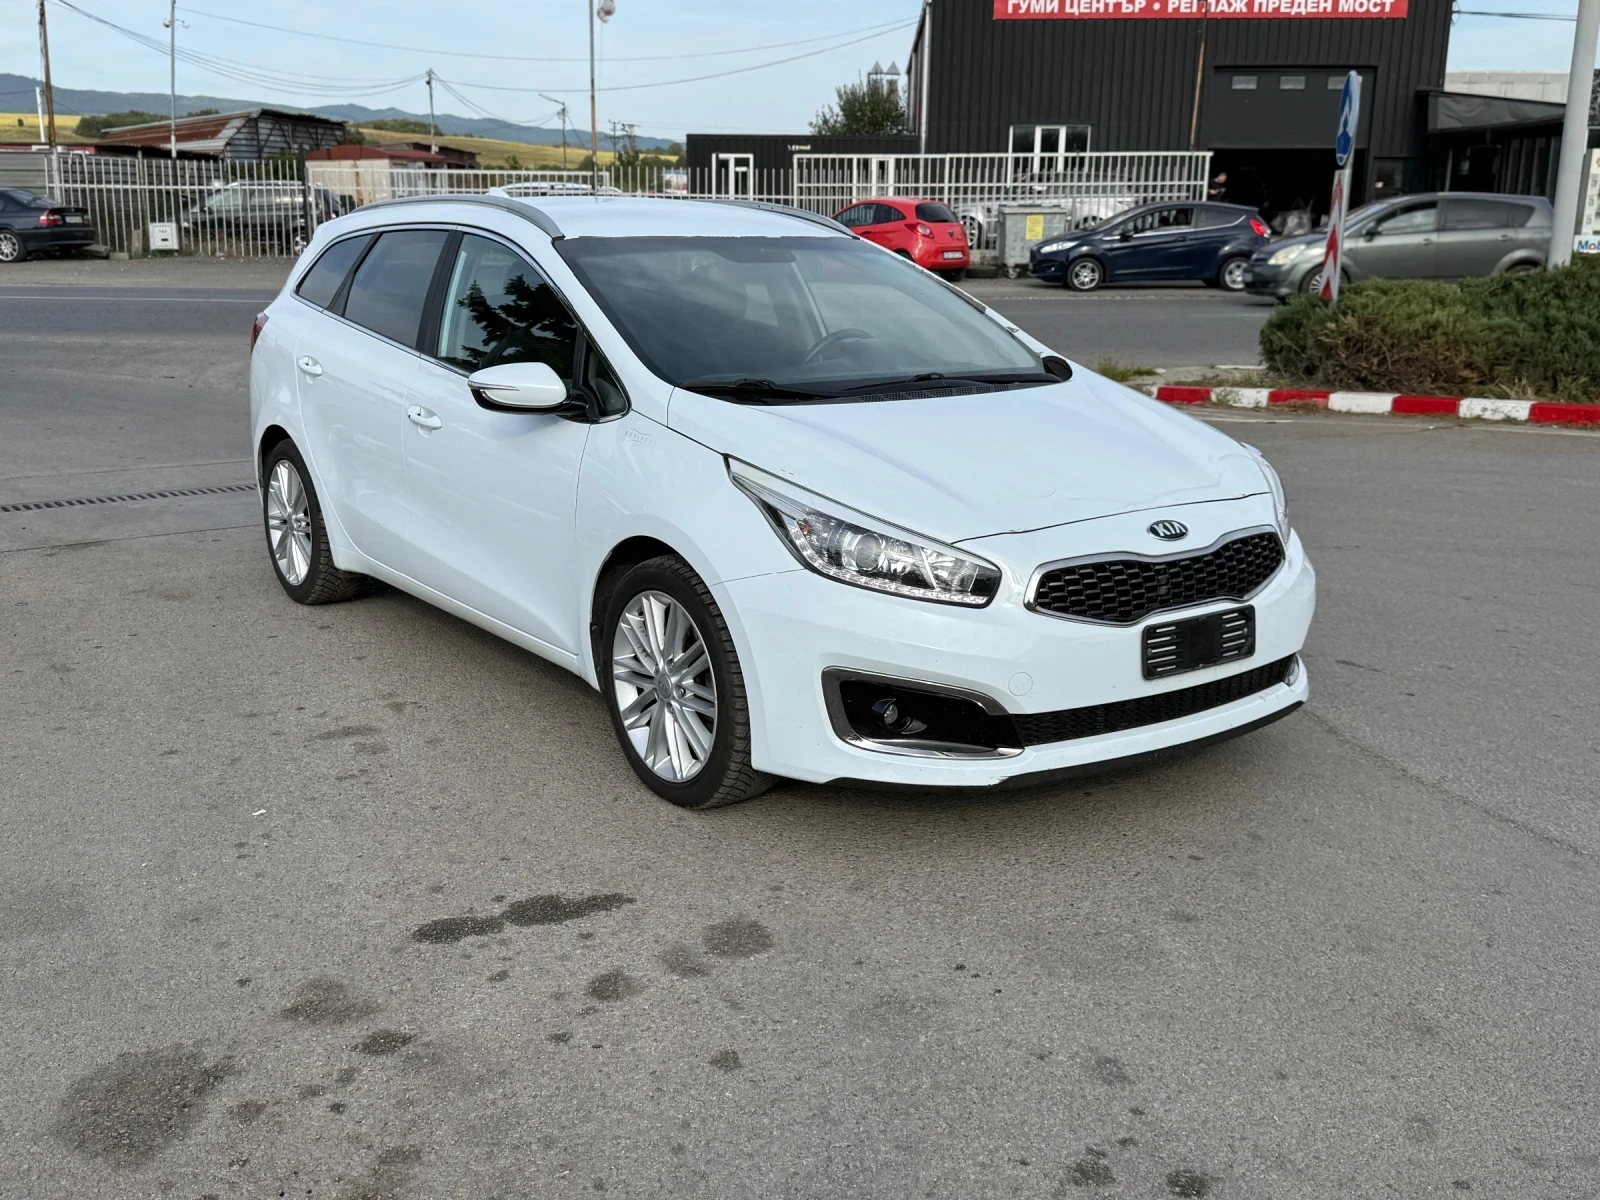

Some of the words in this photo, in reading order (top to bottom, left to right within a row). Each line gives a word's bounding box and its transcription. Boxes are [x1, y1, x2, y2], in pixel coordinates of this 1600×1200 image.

[1007, 0, 1059, 13] ГУМИ
[1064, 0, 1147, 15] ЦЕНТЪР
[1253, 0, 1333, 15] ПРЕДЕН
[1338, 0, 1395, 13] МОСТ
[1151, 521, 1187, 537] KIA
